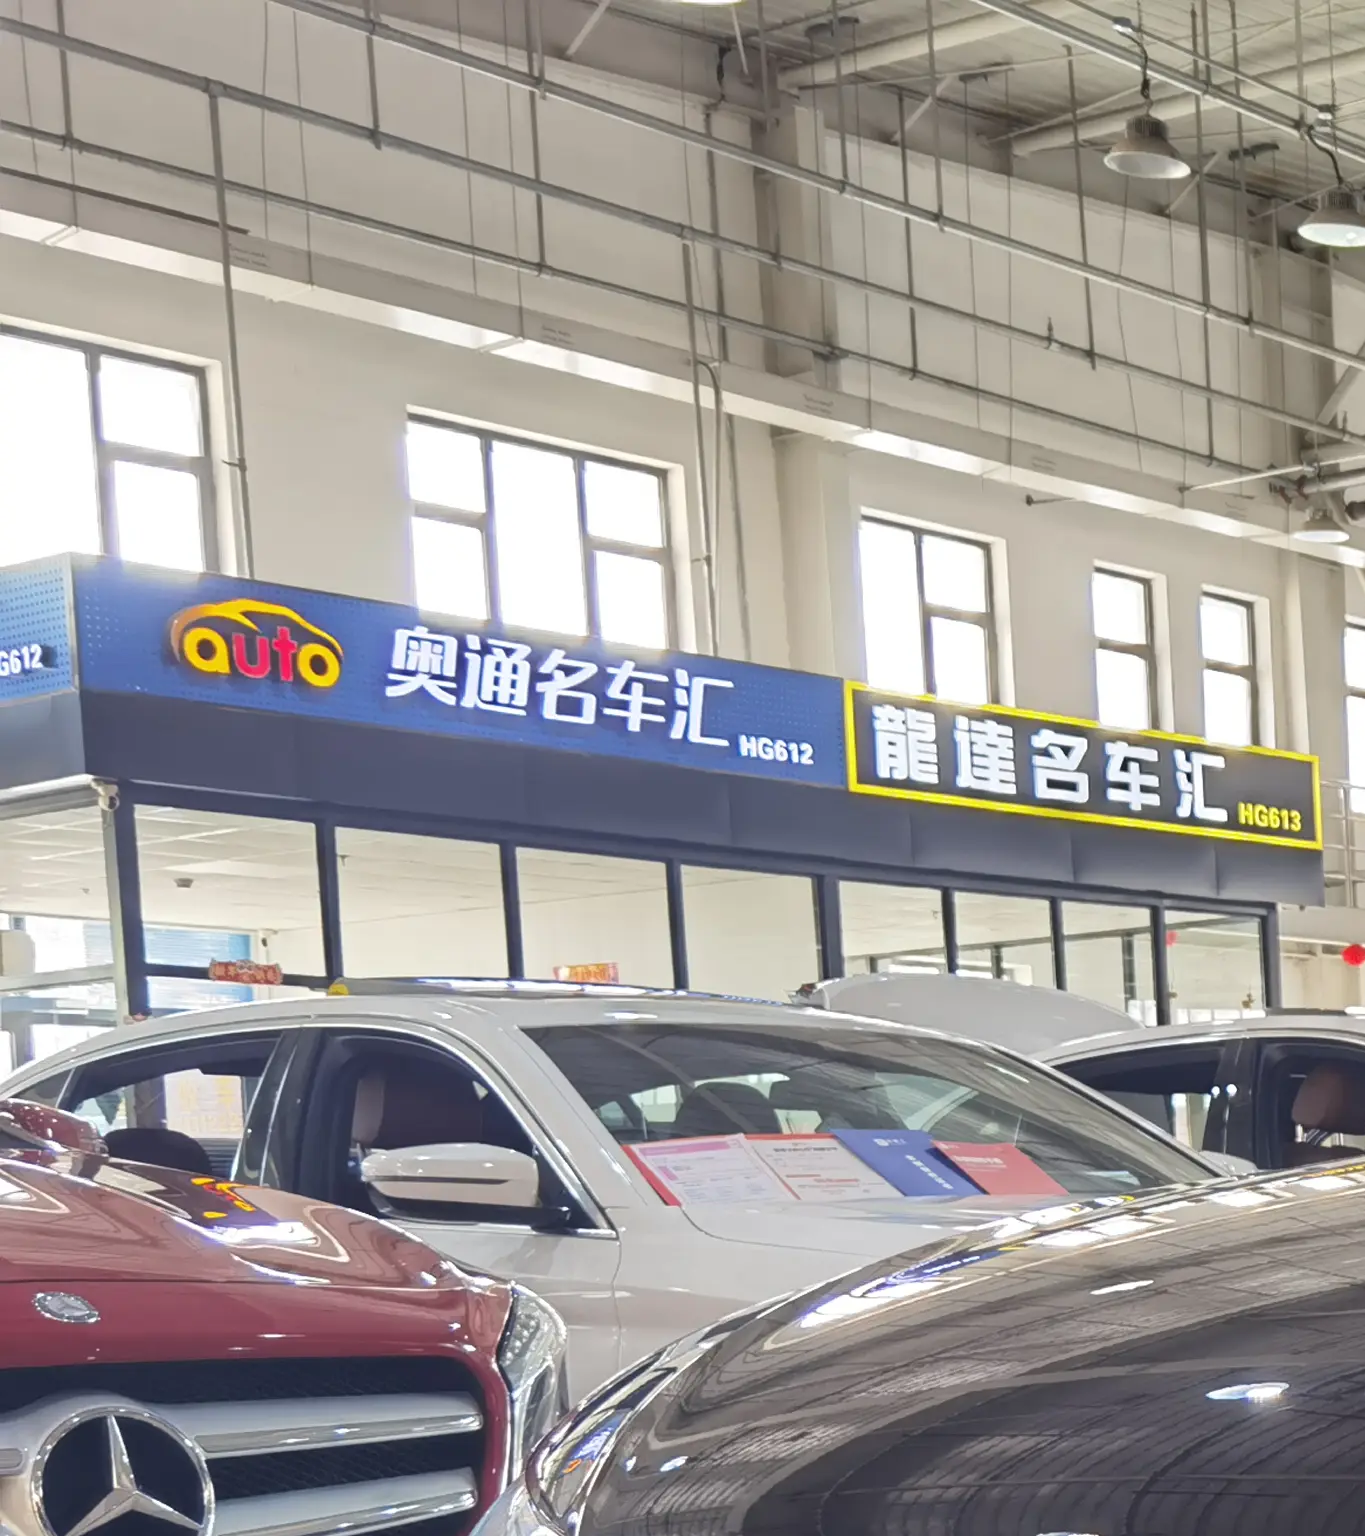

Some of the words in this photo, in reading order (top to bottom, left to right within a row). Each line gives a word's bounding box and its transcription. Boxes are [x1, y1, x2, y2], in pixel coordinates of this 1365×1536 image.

[182, 627, 341, 688] auto
[384, 626, 736, 748] 奥通名车汇
[738, 734, 814, 766] HG612
[872, 704, 1228, 822] 龍達名车汇
[1238, 801, 1303, 833] HG613
